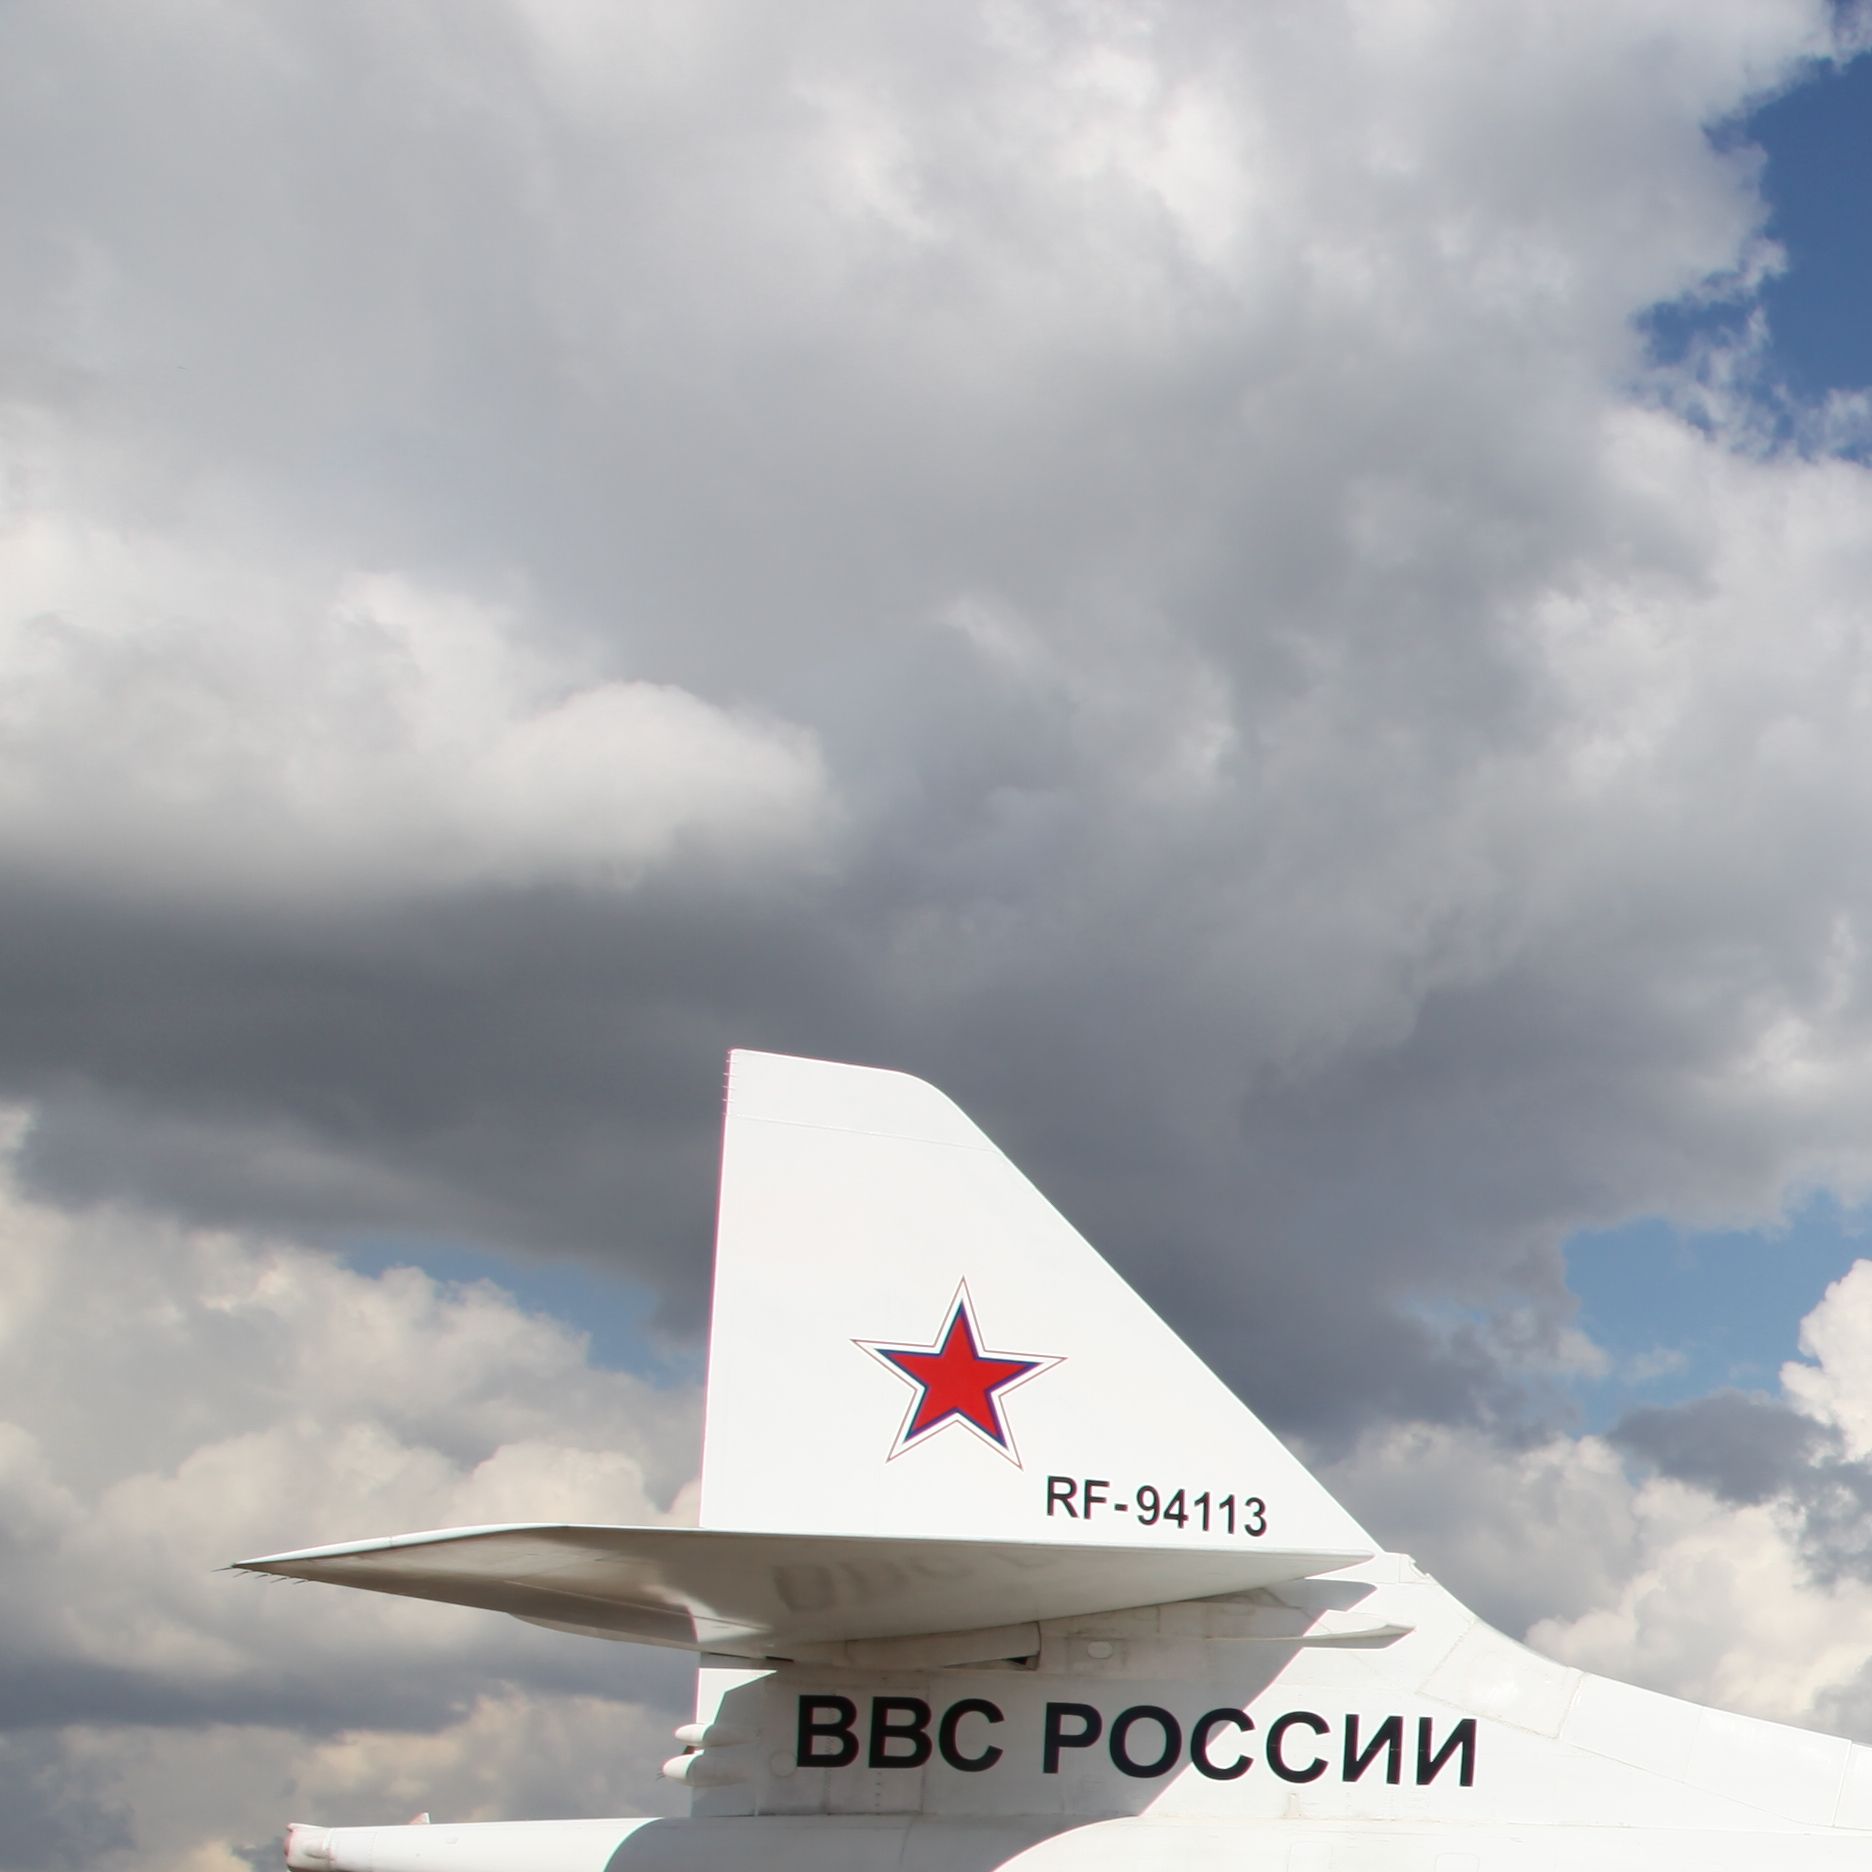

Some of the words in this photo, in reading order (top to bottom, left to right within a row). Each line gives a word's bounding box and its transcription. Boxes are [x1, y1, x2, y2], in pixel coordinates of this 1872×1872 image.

[1046, 1475, 1268, 1537] RF-94113
[794, 1691, 1005, 1773] ВВС
[1042, 1701, 1475, 1787] РОССИИ
